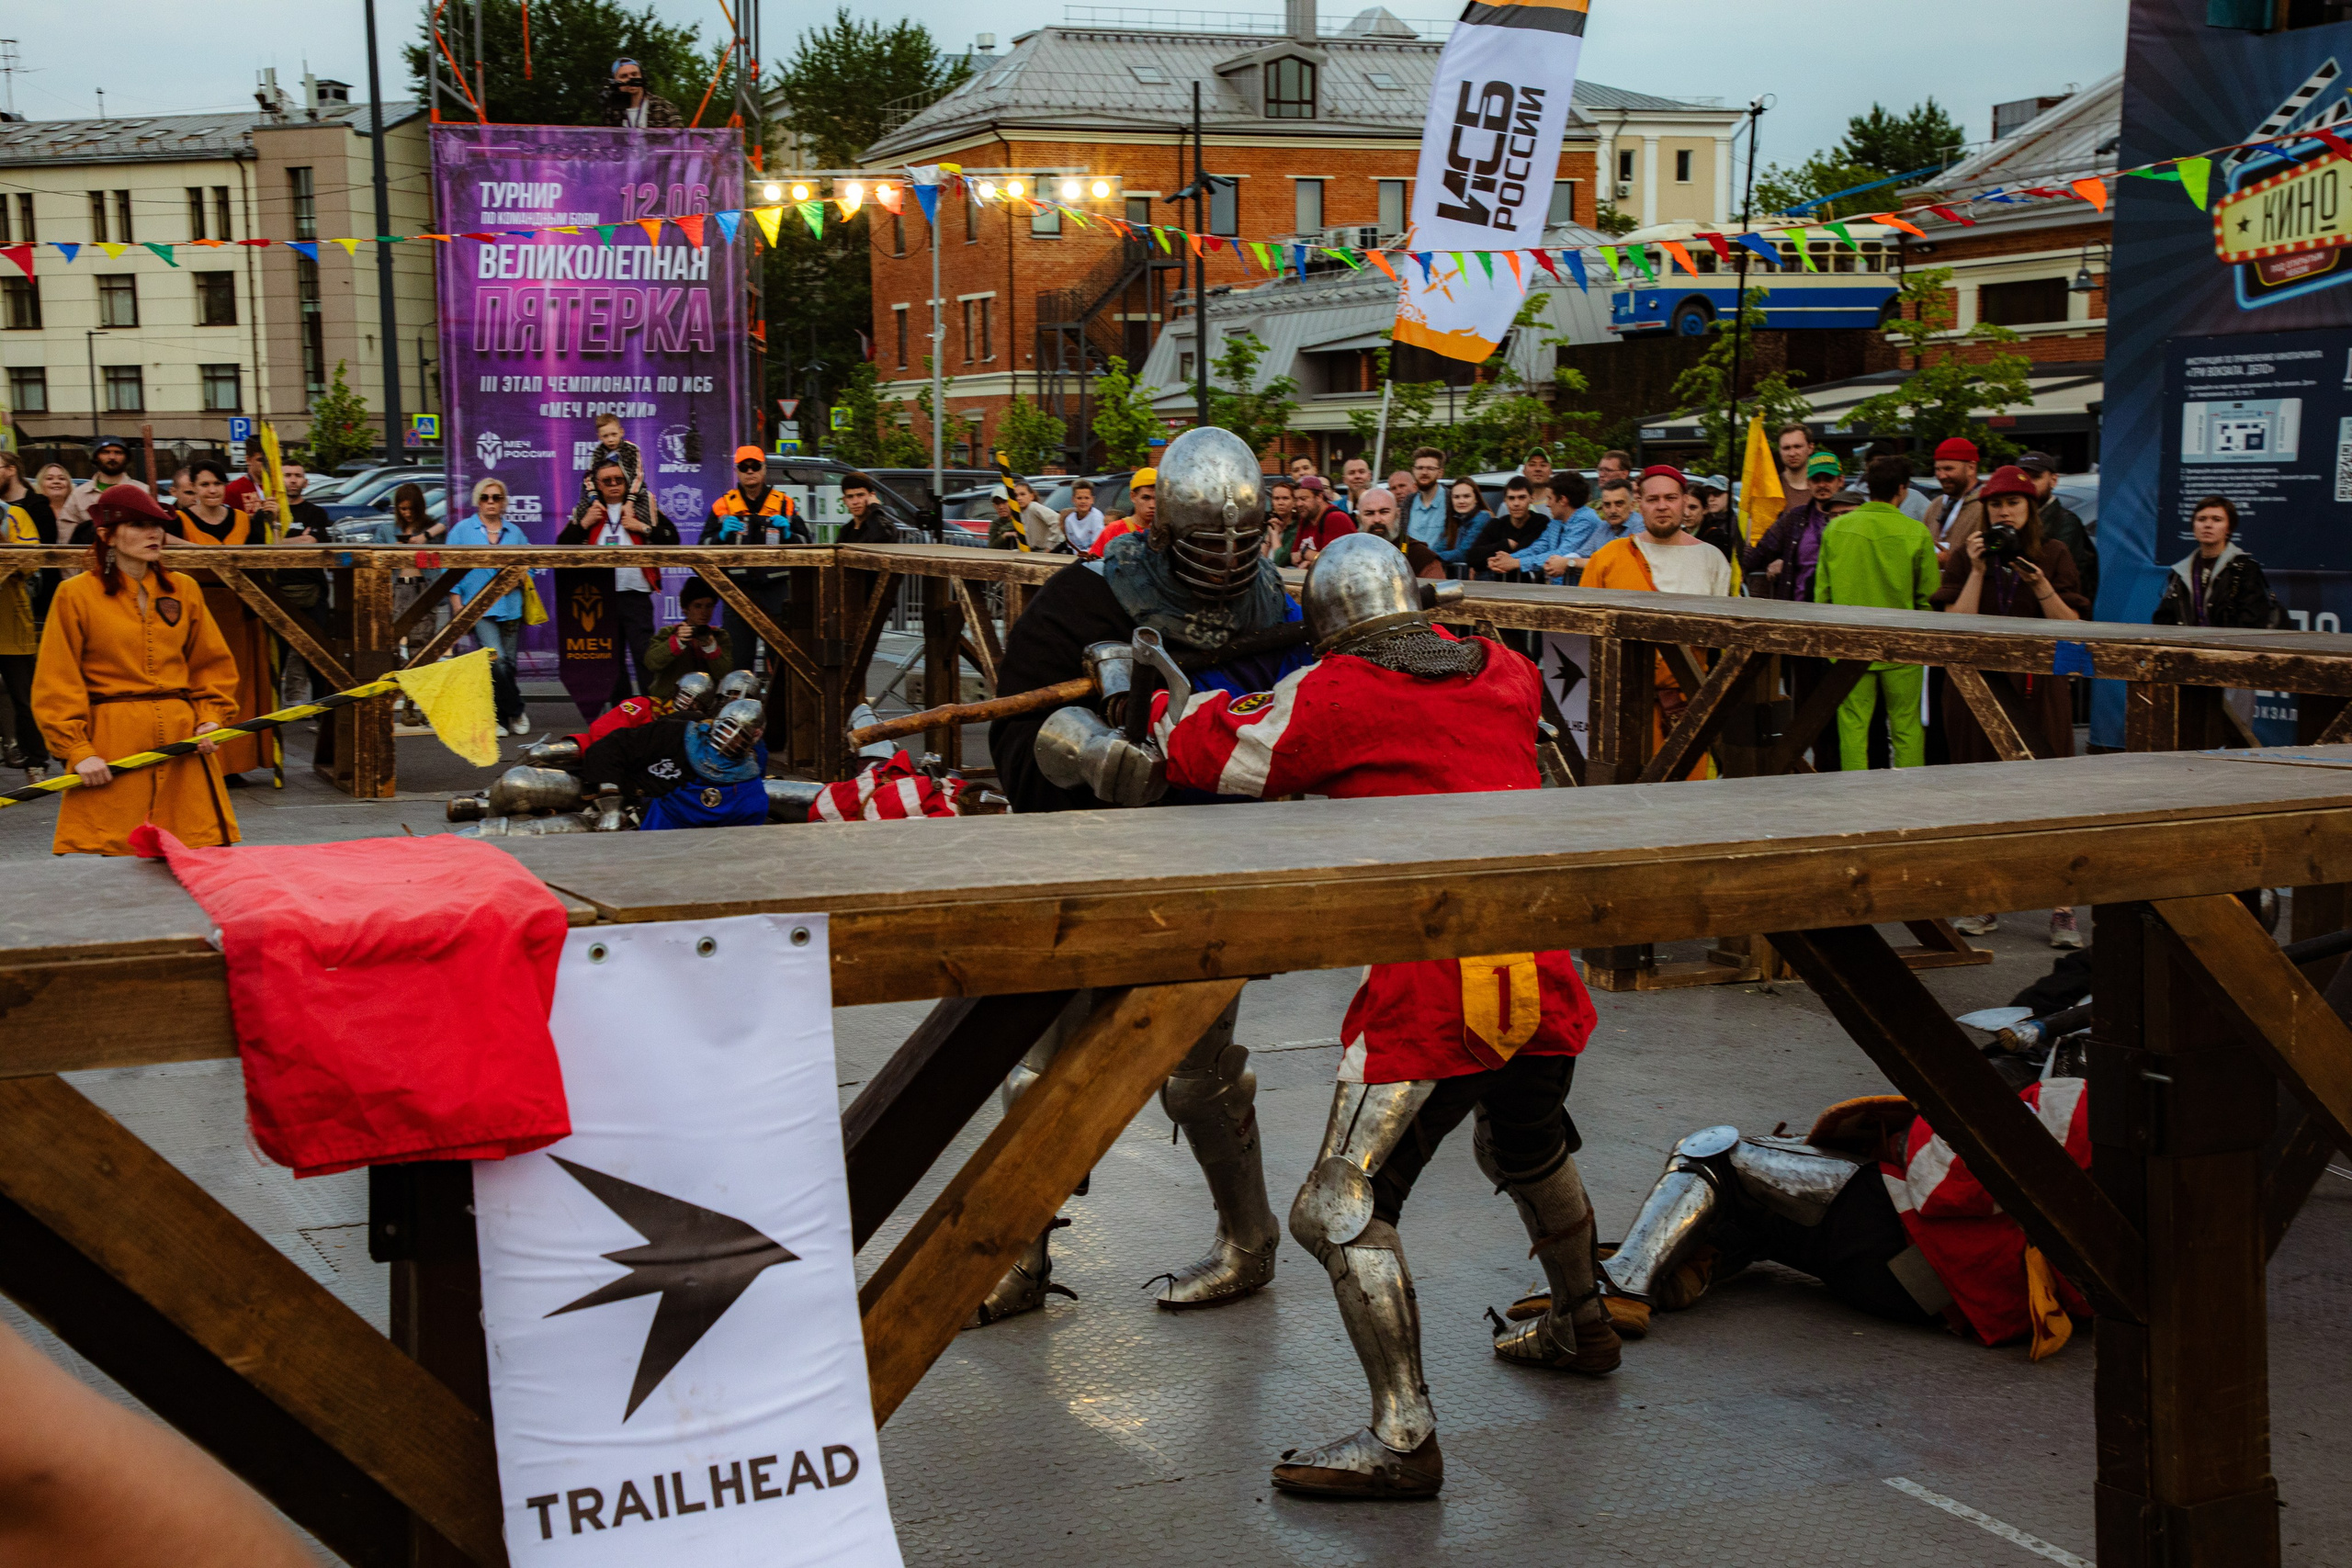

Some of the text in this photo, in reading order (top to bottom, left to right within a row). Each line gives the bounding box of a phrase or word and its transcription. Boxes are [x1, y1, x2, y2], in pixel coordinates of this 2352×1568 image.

[1436, 79, 1515, 228] ИСБ
[1493, 85, 1547, 232] РОССИИ
[479, 182, 563, 209] ТУРНИР
[620, 183, 710, 222] 12.06
[2261, 169, 2338, 243] КИНО
[481, 211, 600, 226] ПО КОМАНДНЫМ БОЯМ
[478, 243, 711, 280] ВЕЛИКОЛЕПНАЯ
[473, 287, 716, 353] ПЯТЕРКА
[480, 376, 713, 393] III ЭТАП ЧЕМПИОНАТА ПО ИСБ
[539, 401, 657, 418] «МЕЧ РОССИИ»
[233, 419, 248, 438] P
[503, 450, 556, 458] РОССИИ
[503, 513, 542, 522] ОССИИ
[566, 638, 613, 650] МЕЧ
[526, 1443, 860, 1540] TRAILHEAD
